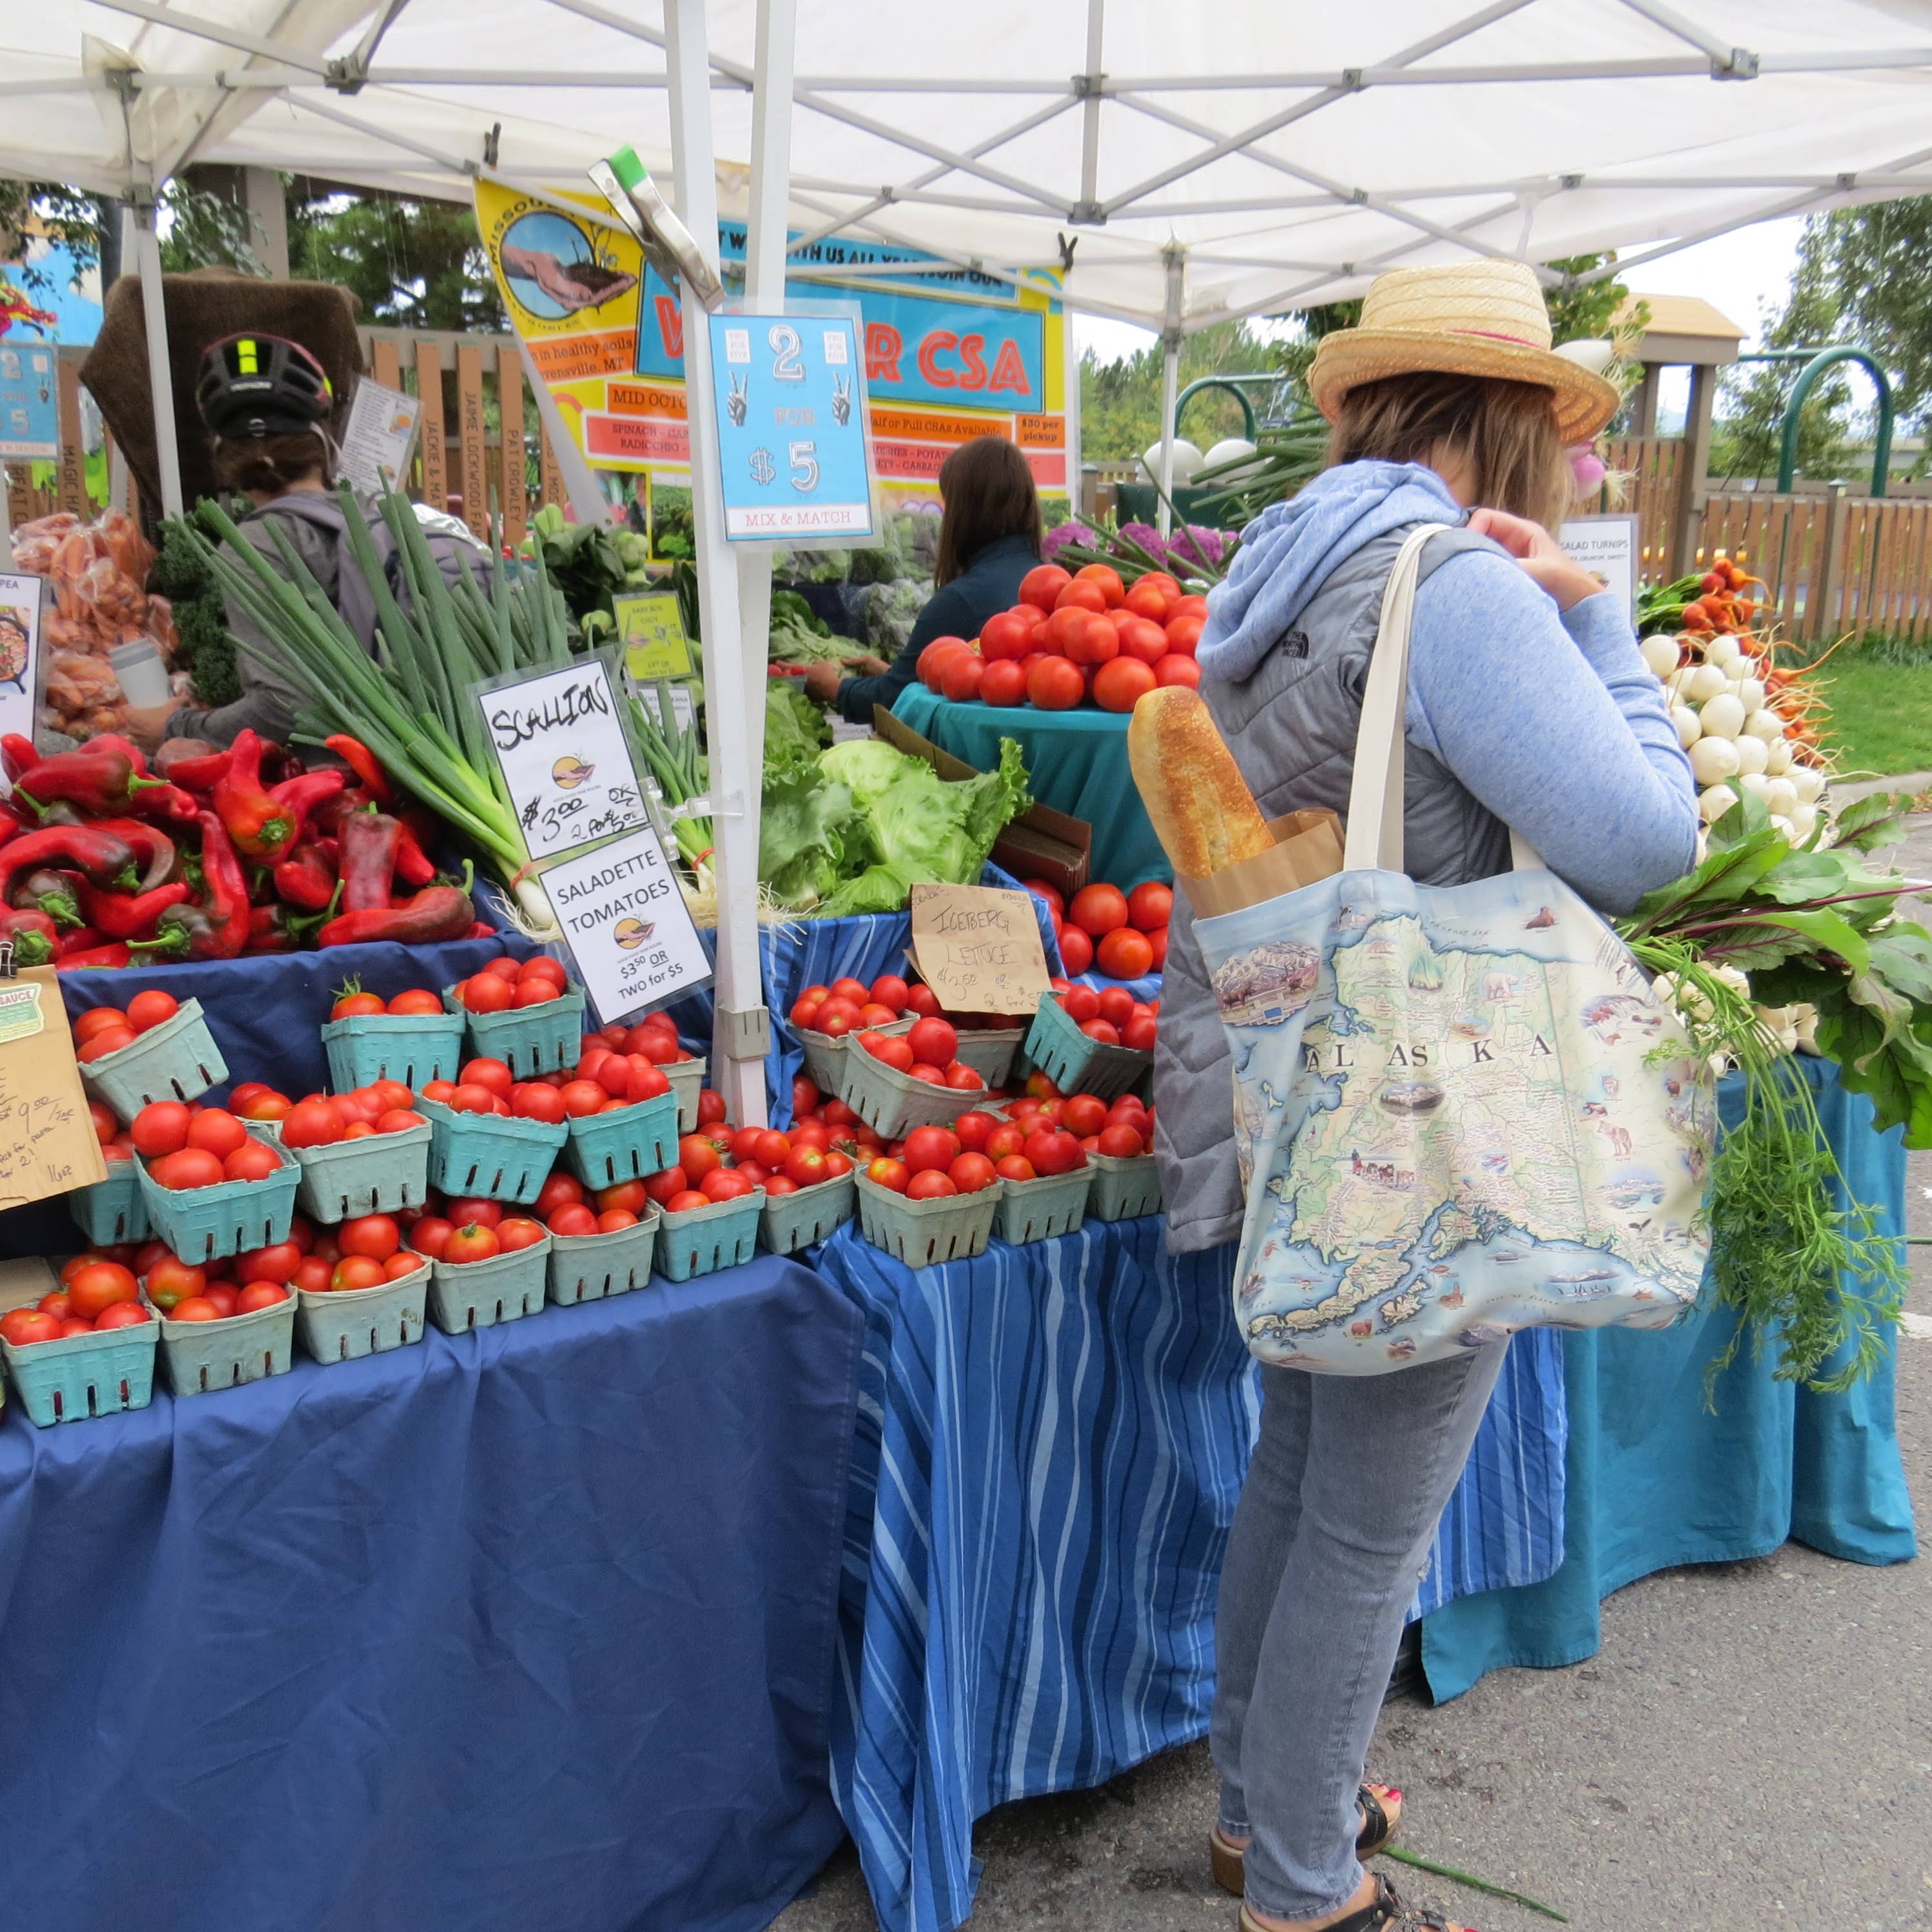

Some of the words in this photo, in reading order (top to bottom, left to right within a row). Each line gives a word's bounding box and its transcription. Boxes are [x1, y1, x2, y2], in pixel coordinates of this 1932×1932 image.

[768, 324, 806, 382] 2
[918, 330, 1031, 395] CSA
[613, 389, 645, 405] MID
[774, 407, 817, 426] FOR
[426, 418, 440, 463] JACKIE
[508, 429, 519, 455] PAT
[612, 424, 657, 437] SPINACH
[64, 445, 79, 489] MAGIC
[467, 437, 481, 507] LOCKWOOD
[508, 461, 521, 522] CROWLEY
[745, 513, 777, 527] MIX
[781, 512, 793, 526] &
[797, 511, 852, 525] MATCH
[1591, 539, 1629, 550] TURNIPS
[492, 675, 609, 752] SCALLION
[557, 850, 657, 905] SALADETTE
[568, 879, 670, 934] TOMATOES
[930, 903, 1011, 936] ICEBERG
[650, 950, 670, 968] OR
[945, 941, 1019, 967] LETTUCE
[618, 980, 647, 1000] TWO
[649, 971, 666, 986] for
[668, 963, 684, 978] $5
[1304, 1033, 1554, 1074] ALASKA
